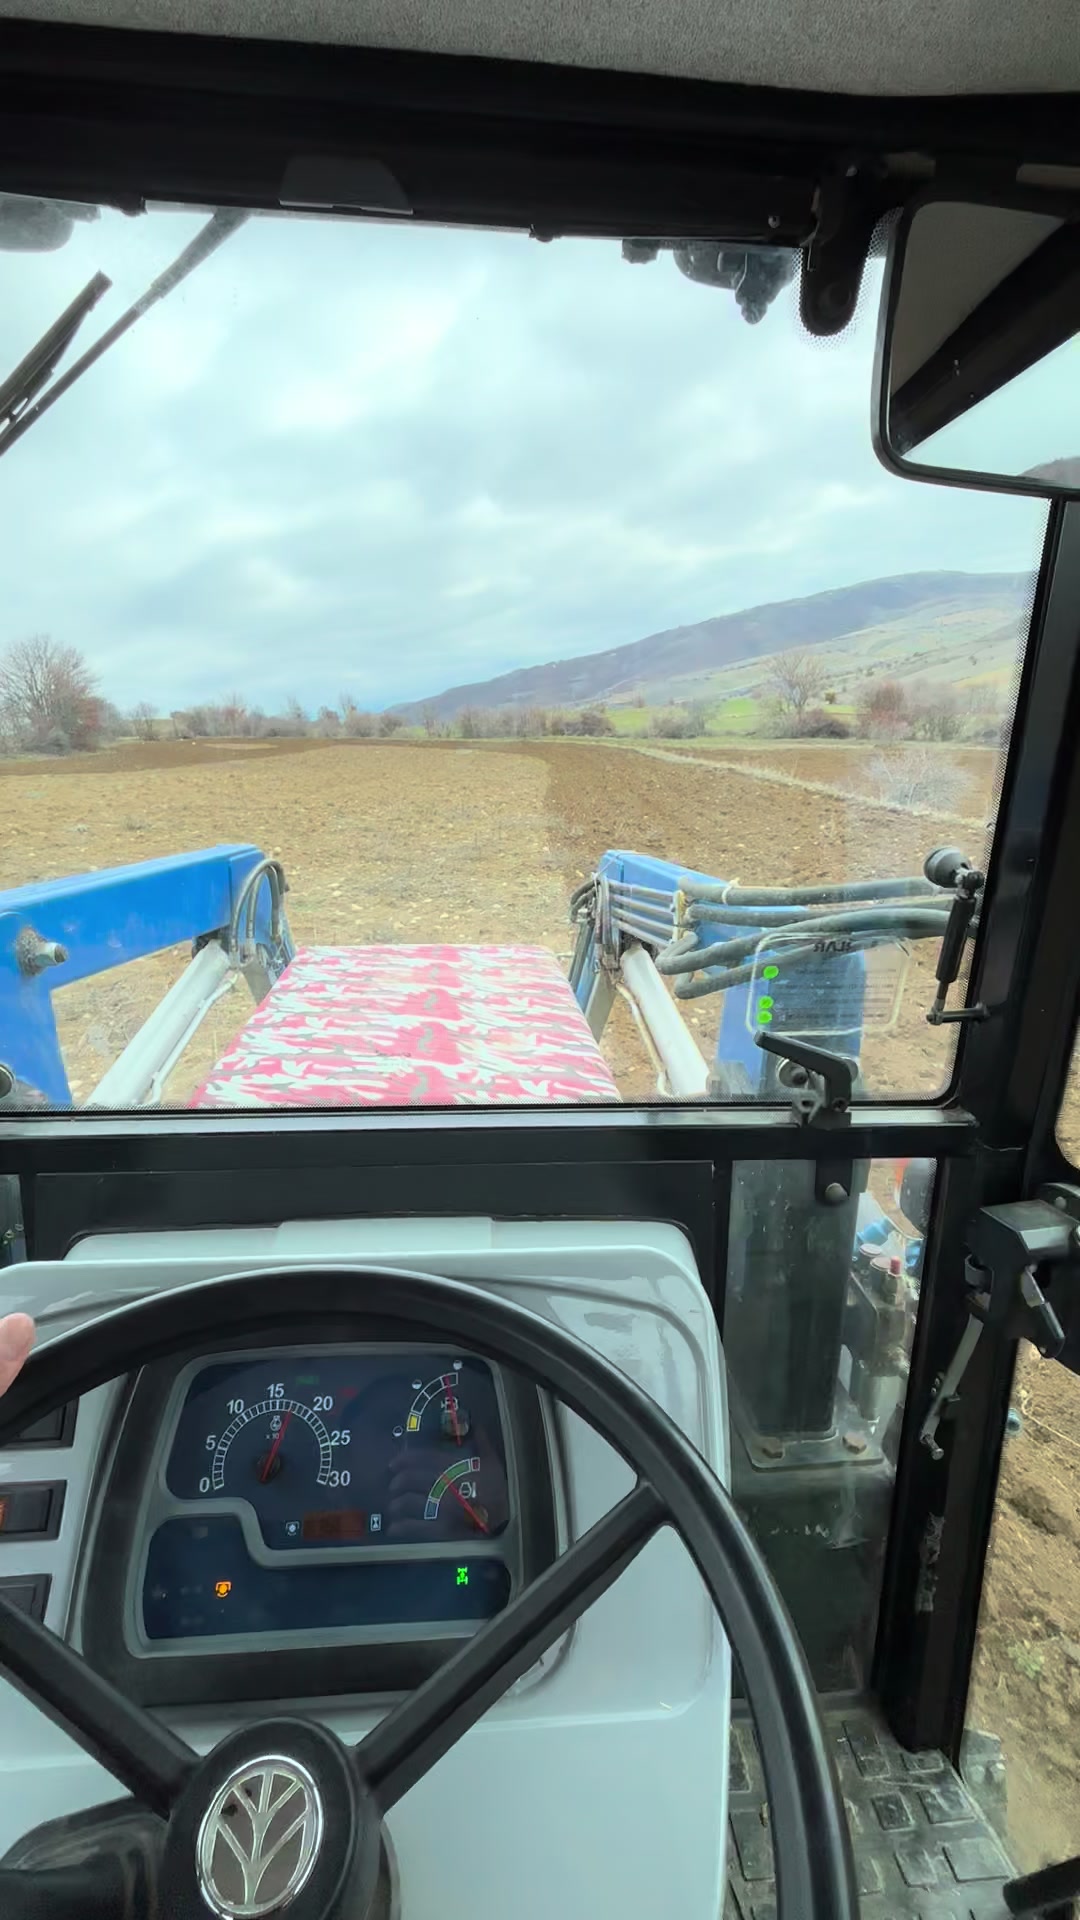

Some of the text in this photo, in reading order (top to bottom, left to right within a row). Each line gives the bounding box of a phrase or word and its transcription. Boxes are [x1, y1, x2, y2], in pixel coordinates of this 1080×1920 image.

[267, 1383, 285, 1398] 15
[226, 1399, 245, 1414] 10
[313, 1395, 333, 1411] 20
[205, 1435, 217, 1451] 5
[330, 1430, 351, 1446] 25
[199, 1477, 210, 1493] 0
[329, 1470, 351, 1488] 30
